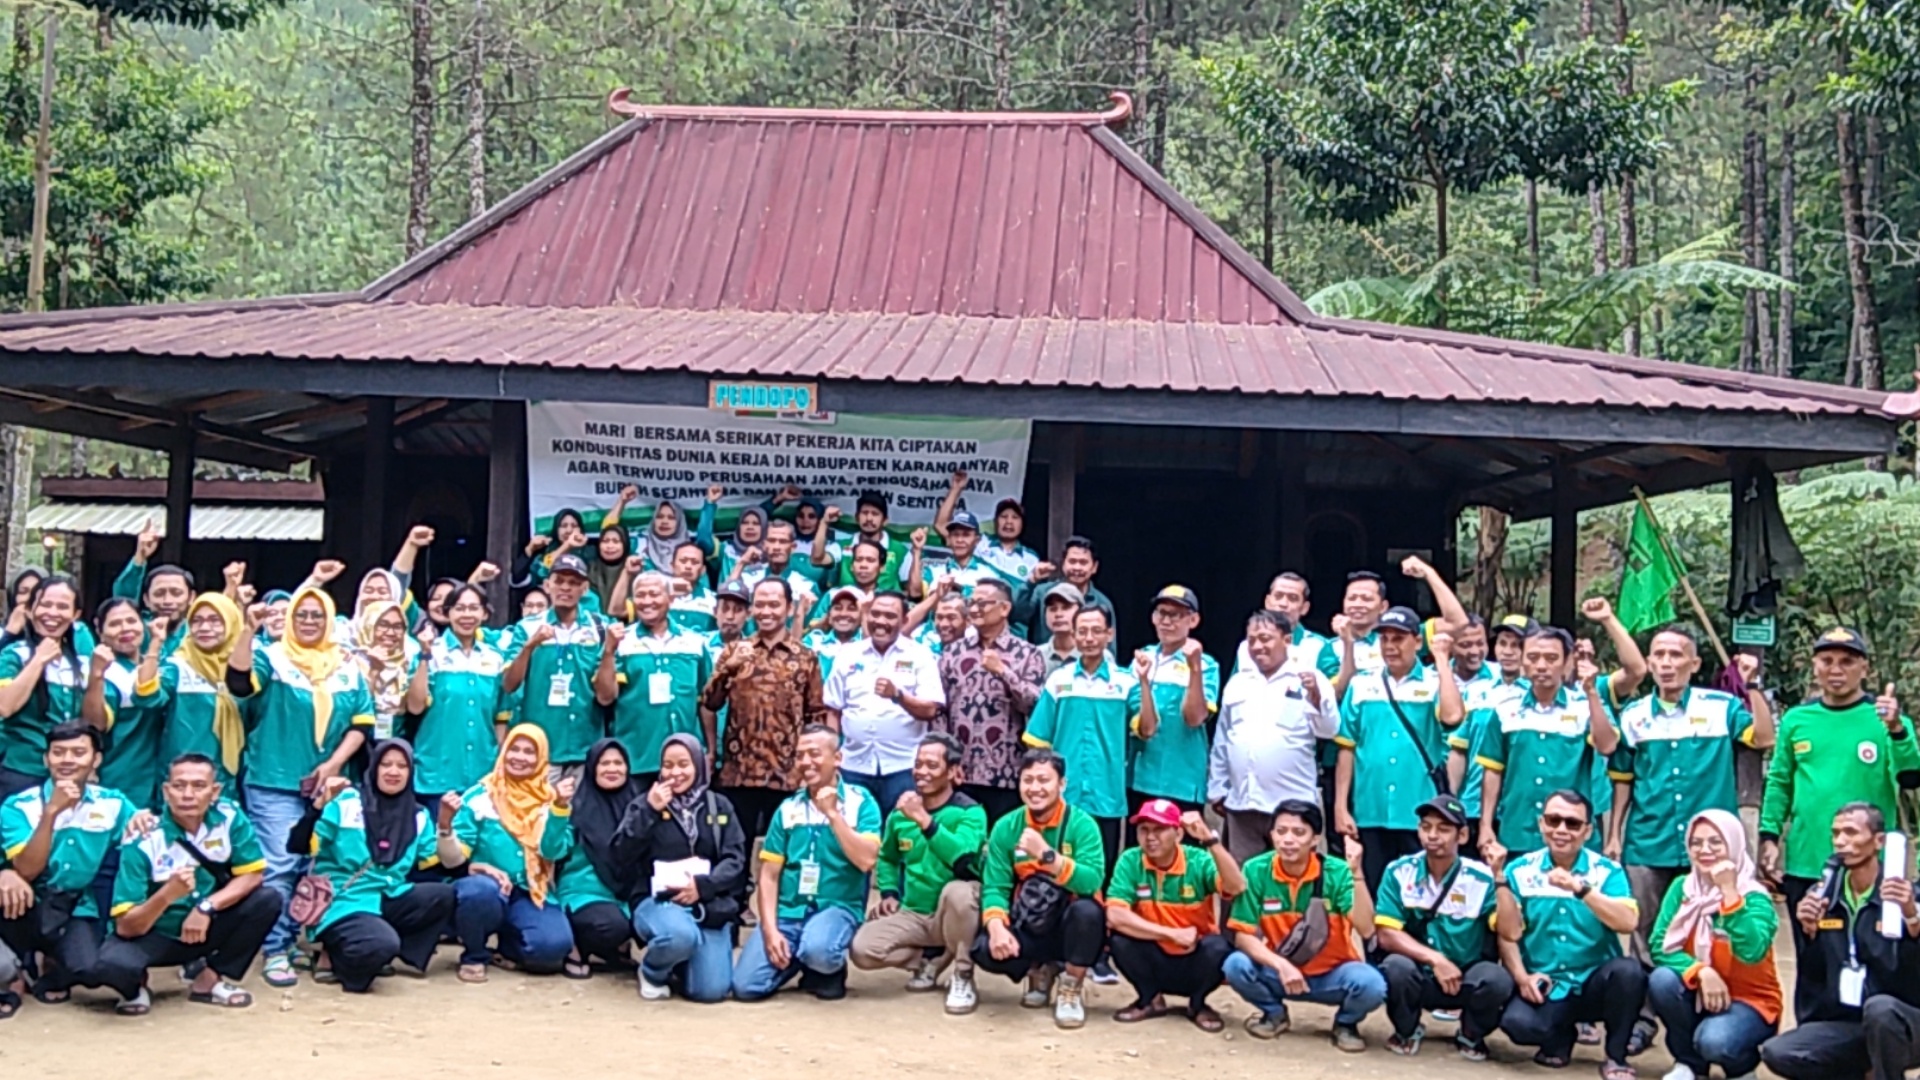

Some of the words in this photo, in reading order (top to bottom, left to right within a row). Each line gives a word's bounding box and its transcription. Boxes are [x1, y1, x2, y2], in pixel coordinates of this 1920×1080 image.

[716, 384, 809, 410] PENDOPO
[585, 422, 625, 438] MARI
[634, 426, 711, 443] BERSAMA
[715, 430, 782, 447] SERIKAT
[786, 434, 855, 451] PEKERJA
[860, 438, 894, 452] KITA
[899, 439, 977, 454] CIPTAKAN
[552, 439, 662, 461] KONDUSIFITAS
[666, 449, 716, 465] DUNIA
[720, 452, 770, 467] KERJA
[774, 455, 790, 468] DI
[795, 456, 887, 471] KABUPATEN
[892, 458, 1010, 475] KARANGANYAR
[567, 460, 610, 475] AGAR
[613, 463, 695, 482] TERWUJUD
[700, 471, 807, 486] PERUSAHAAN
[857, 476, 950, 492] PENGUSAHA
[961, 478, 994, 494] AYA
[595, 481, 649, 497] BURH
